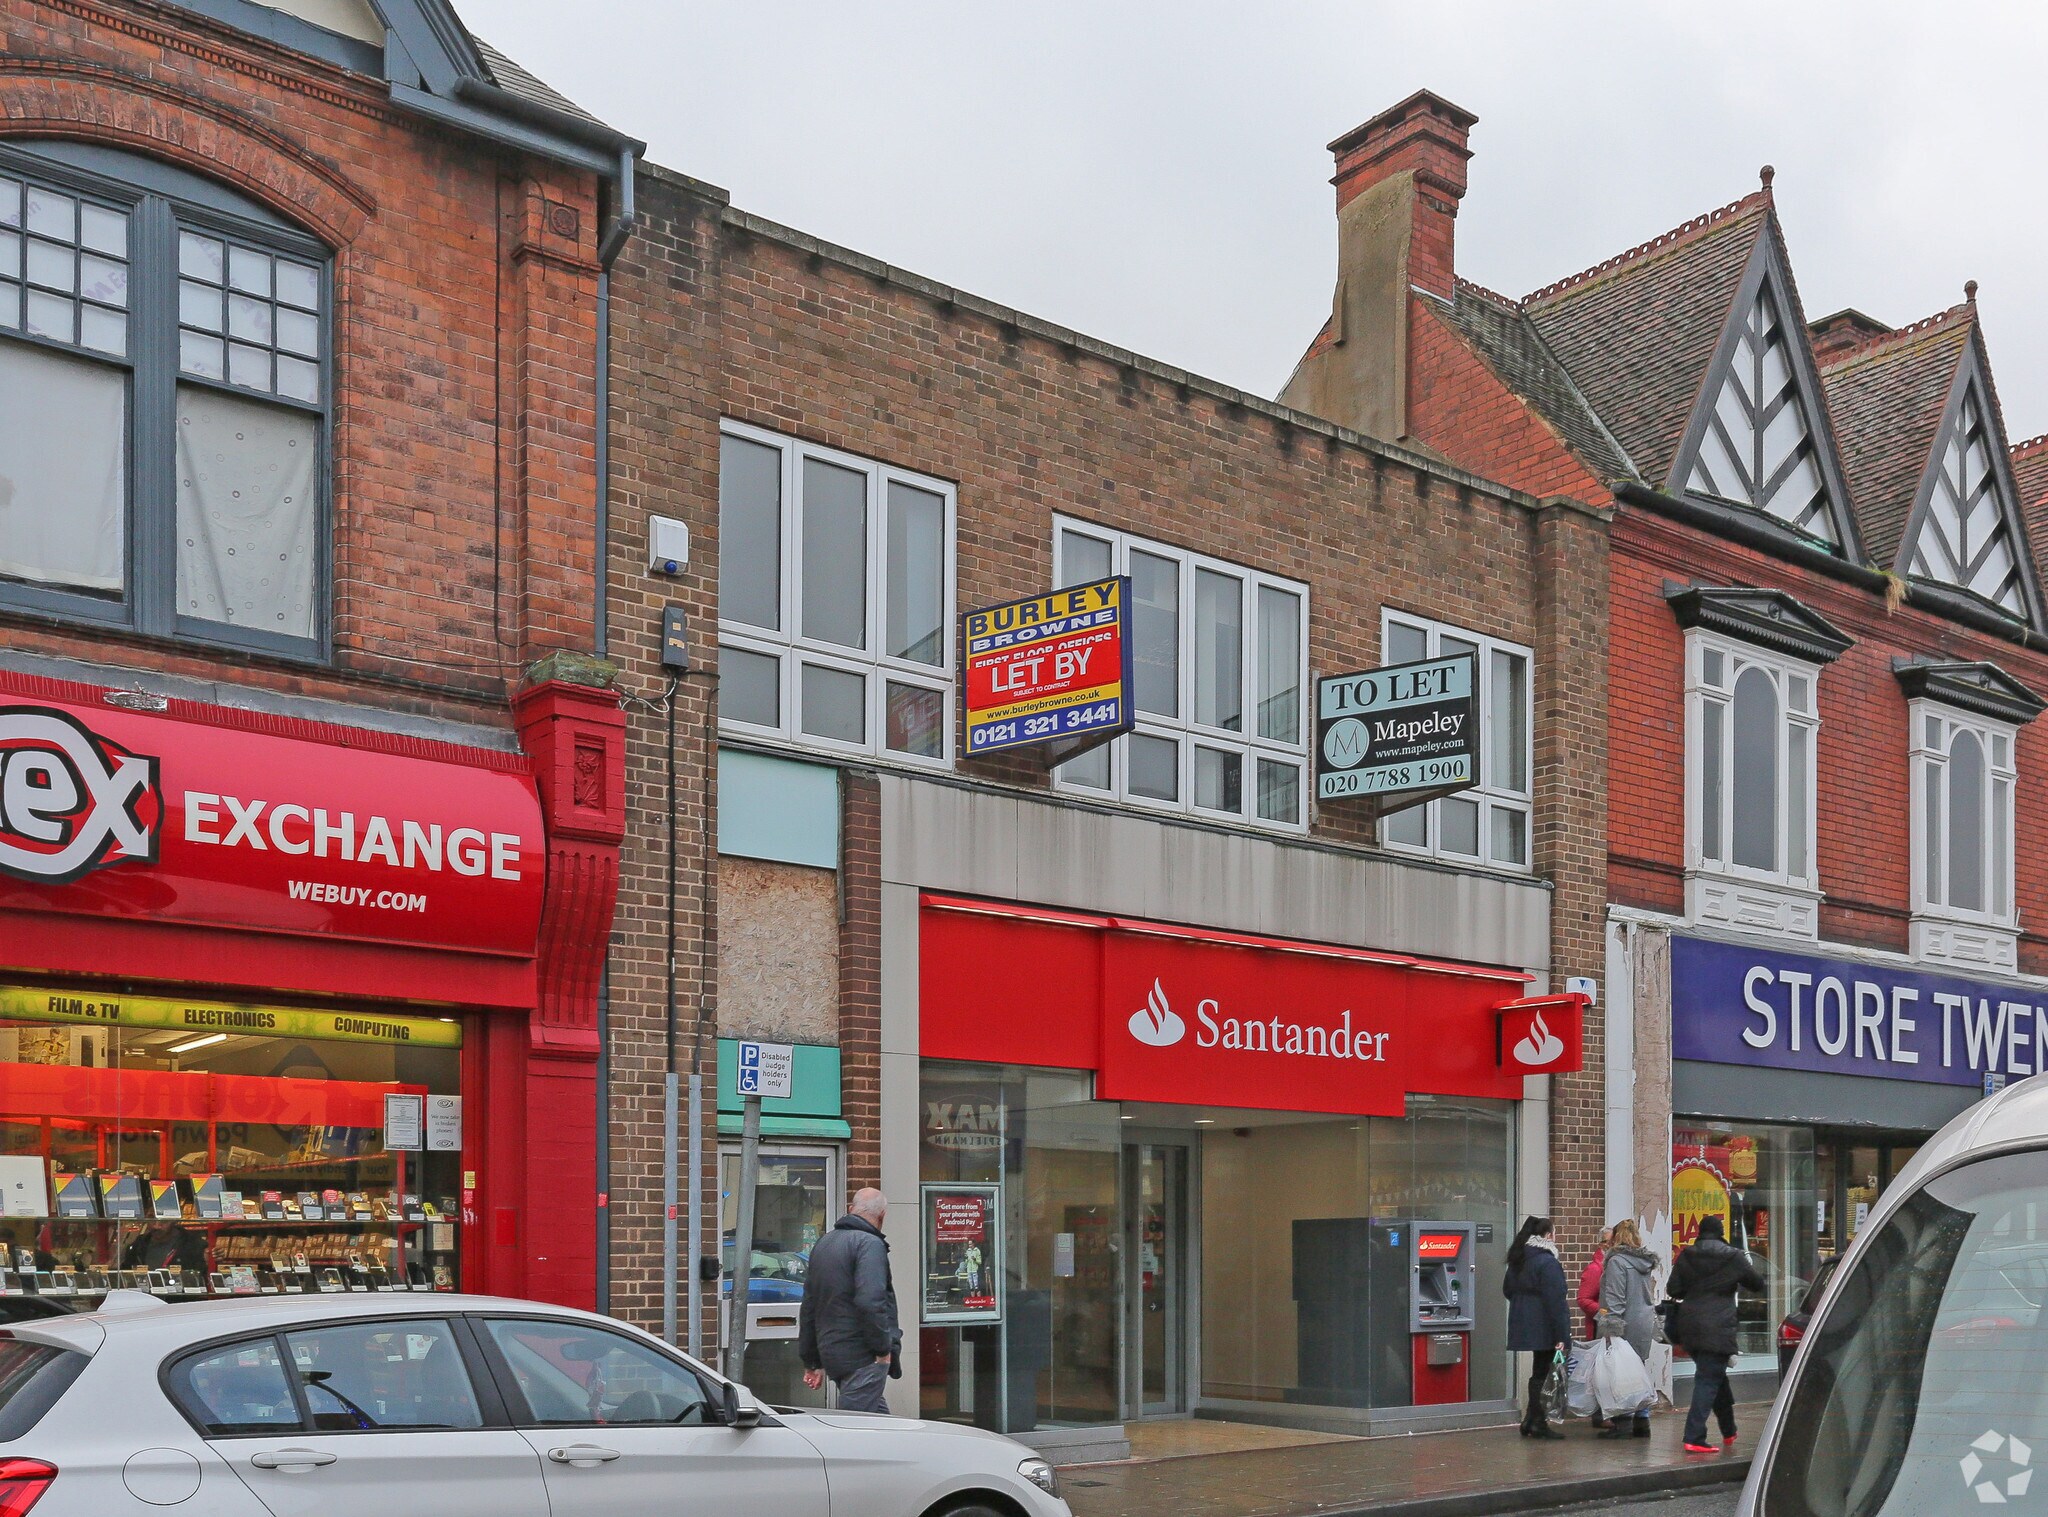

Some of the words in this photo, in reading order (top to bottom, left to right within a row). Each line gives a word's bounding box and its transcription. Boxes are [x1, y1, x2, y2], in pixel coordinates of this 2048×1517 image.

[969, 582, 1116, 635] BURLEY
[973, 609, 1113, 652] BROWNE
[991, 657, 1045, 693] LET
[1055, 647, 1093, 680] BY
[1013, 688, 1035, 697] SUBJECT
[1044, 681, 1071, 691] CONTRACT
[1331, 679, 1378, 710] TO
[1387, 666, 1456, 703] LET
[986, 690, 1100, 720] www.burleybrowne.co.uk
[973, 722, 1016, 745] 0121
[1024, 714, 1059, 737] 321
[1066, 703, 1116, 727] 3441
[1374, 711, 1465, 742] Mapeley
[1375, 738, 1465, 758] www.mapeley.com
[1325, 774, 1358, 795] 020
[1365, 767, 1411, 789] 7788
[1418, 759, 1464, 782] 1900
[0, 713, 150, 875] ex
[184, 790, 521, 882] EXCHANGE
[288, 880, 427, 913] WEBUY.COM
[48, 996, 83, 1016] FILM
[85, 1003, 97, 1017] &
[100, 1003, 120, 1019] TV
[184, 1008, 276, 1028] ELECTRONICS
[1741, 965, 1919, 1064] STORE
[334, 1016, 410, 1040] COMPUTING
[1196, 998, 1389, 1062] Santander
[745, 1046, 757, 1065] P
[761, 1051, 791, 1062] Disabled
[762, 1070, 788, 1079] holders
[767, 1079, 783, 1089] only
[952, 1211, 968, 1219] phone
[1428, 1241, 1456, 1250] Santander
